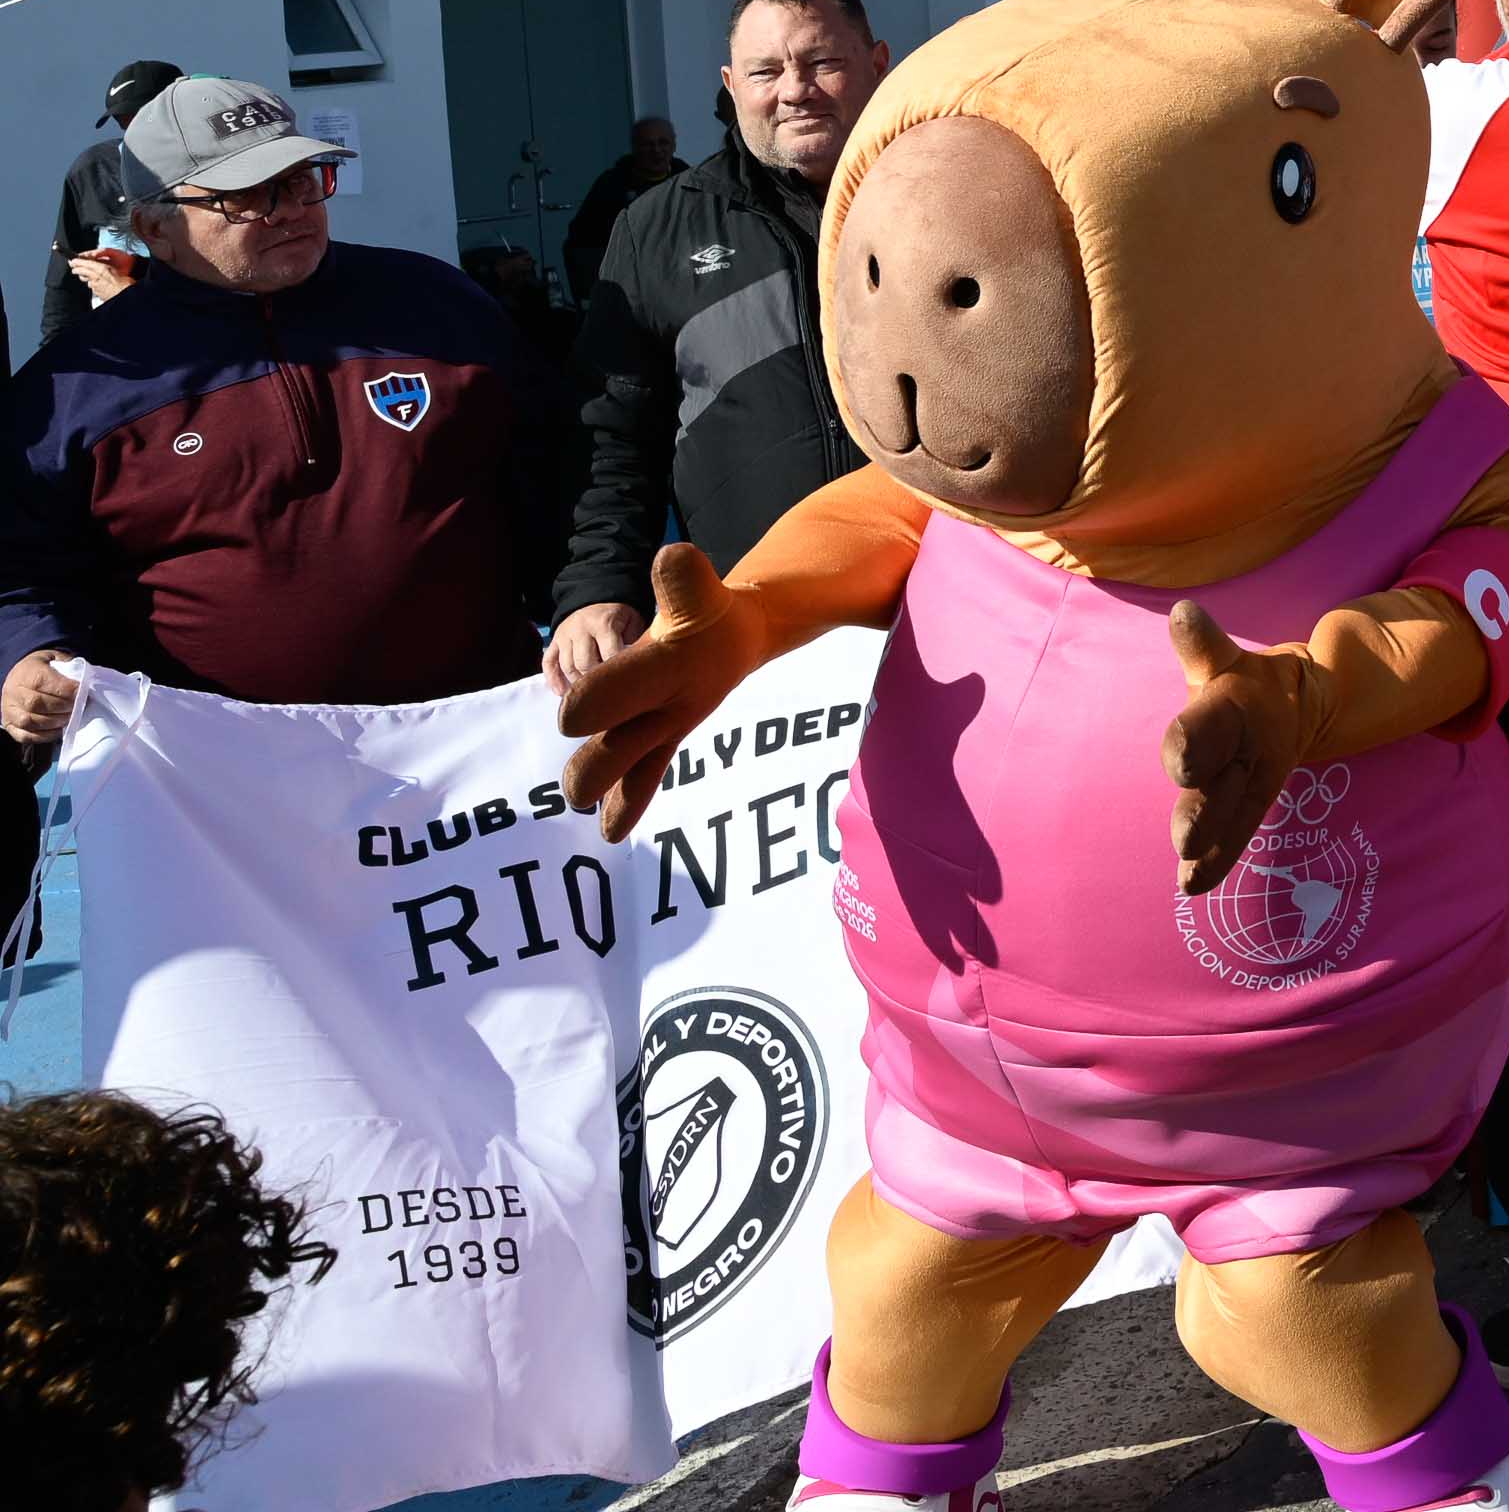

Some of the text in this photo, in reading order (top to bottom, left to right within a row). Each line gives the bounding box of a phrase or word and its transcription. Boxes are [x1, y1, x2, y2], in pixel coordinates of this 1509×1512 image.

[358, 798, 517, 867] CLUB
[714, 727, 741, 769] Y
[1248, 828, 1328, 853] ODESUR
[392, 769, 849, 993] RIO NEG
[1231, 959, 1337, 992] DEPORTIVA
[1336, 821, 1380, 960] SURAMERICANA
[674, 1013, 698, 1040] Y
[706, 1011, 806, 1185] DEPORTIVO
[358, 1184, 527, 1235] DESDE
[387, 1236, 520, 1290] 1939
[662, 1217, 763, 1322] NEGRO
